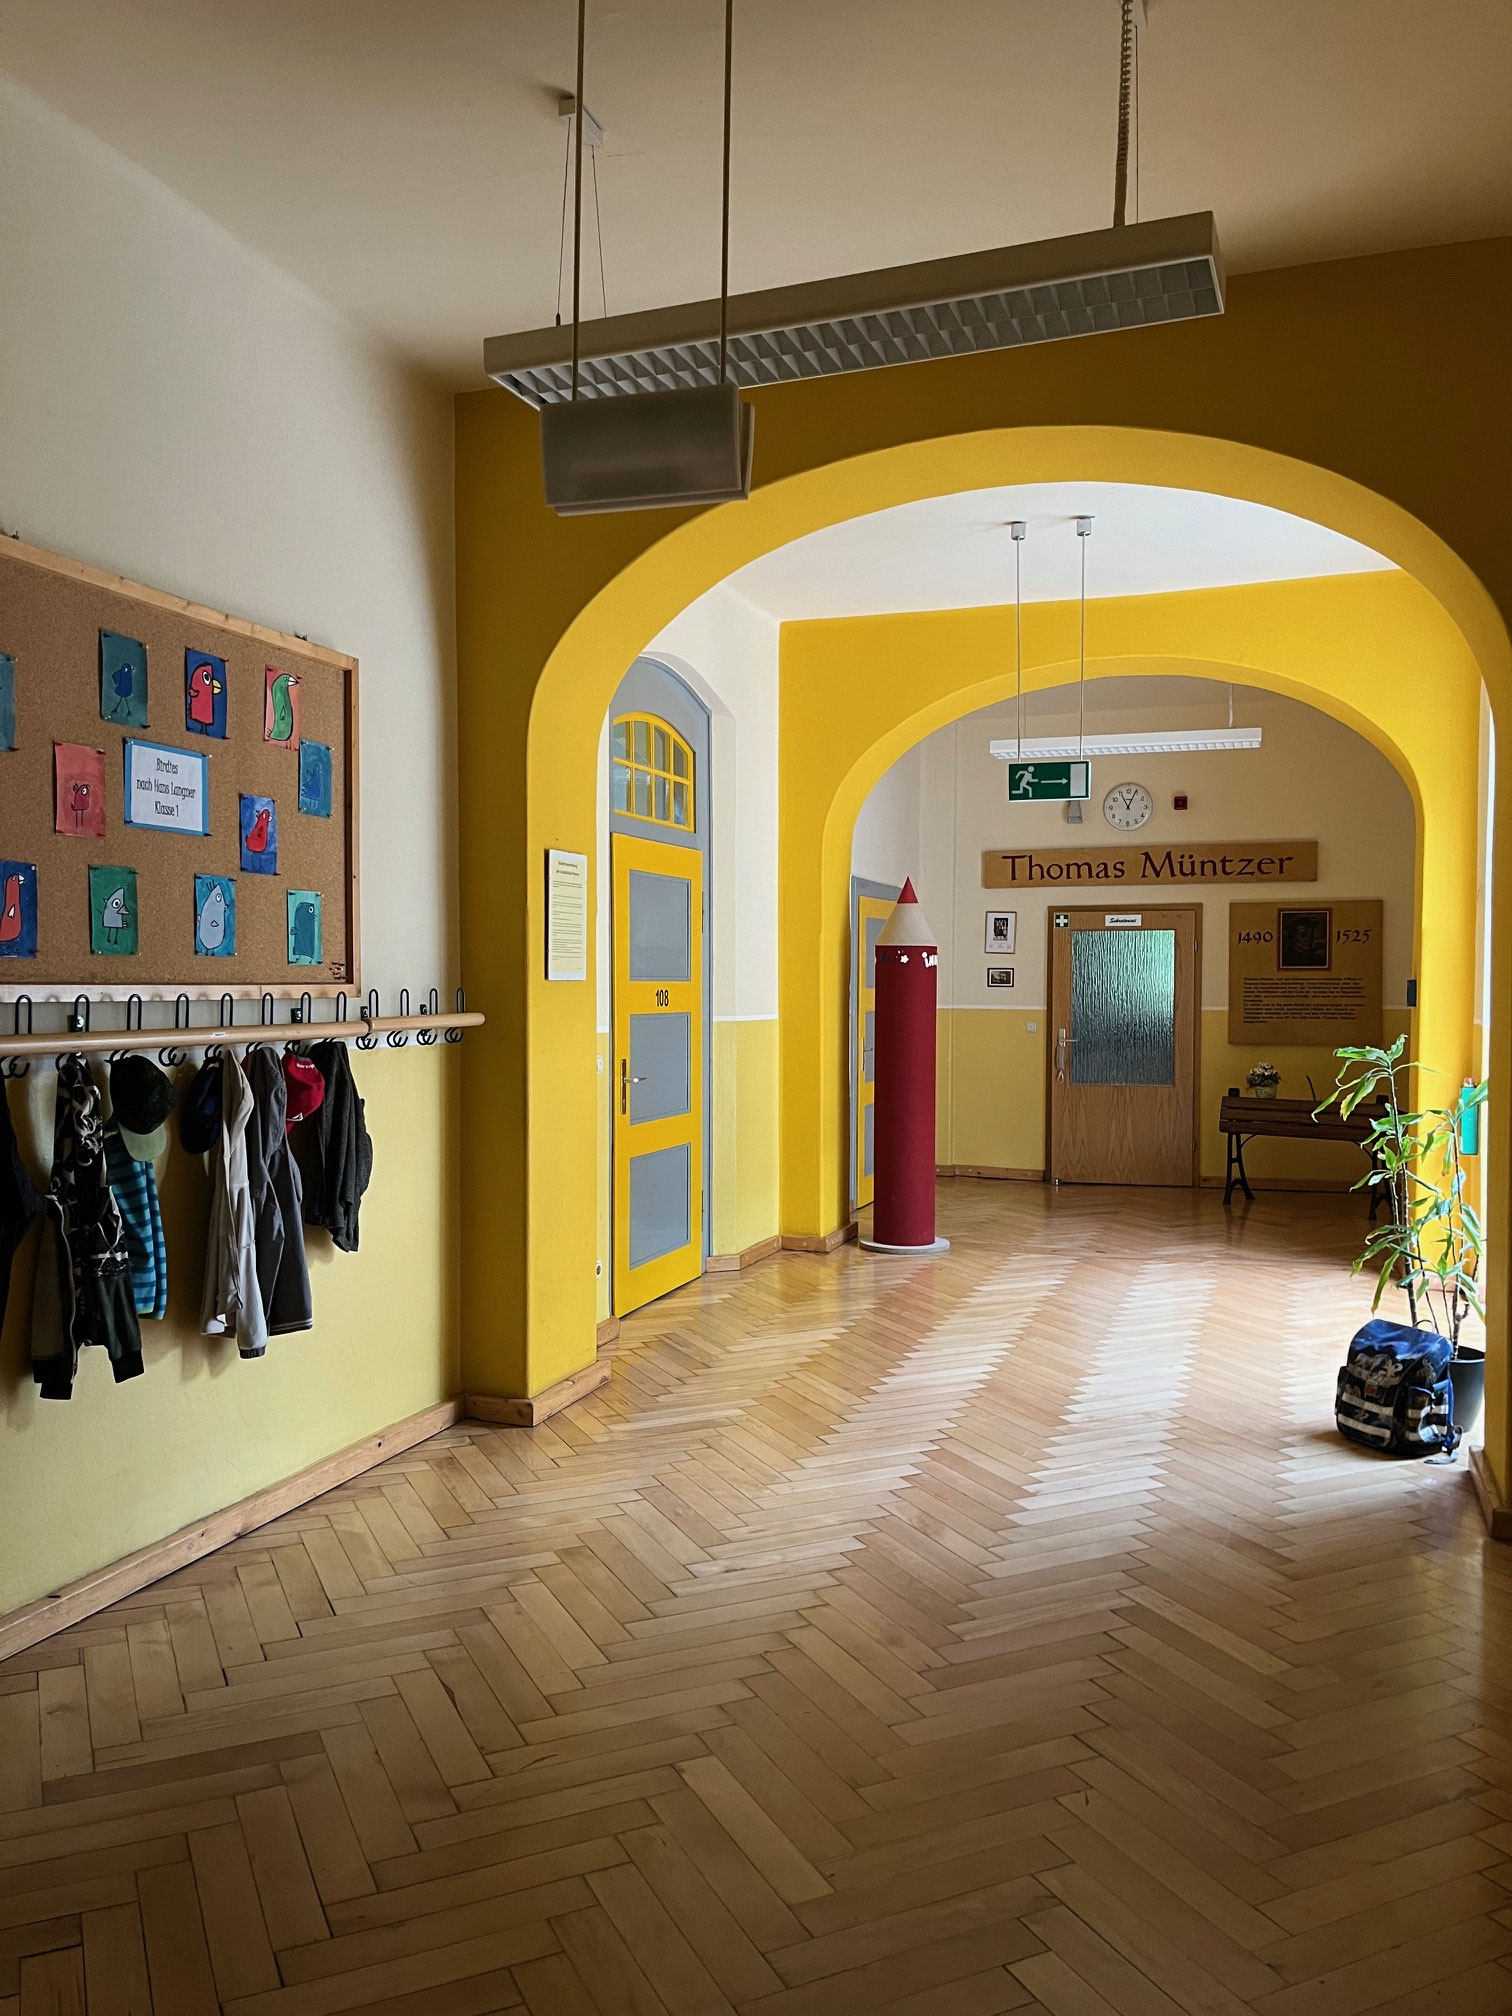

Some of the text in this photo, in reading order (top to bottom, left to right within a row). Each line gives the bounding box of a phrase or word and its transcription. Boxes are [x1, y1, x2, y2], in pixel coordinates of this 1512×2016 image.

[136, 778, 195, 800] nach Hans Langner
[155, 801, 179, 817] Klasse 1
[1001, 851, 1294, 882] Thomas Müntzer
[1236, 928, 1373, 945] 1490 1525
[656, 989, 669, 1006] 108
